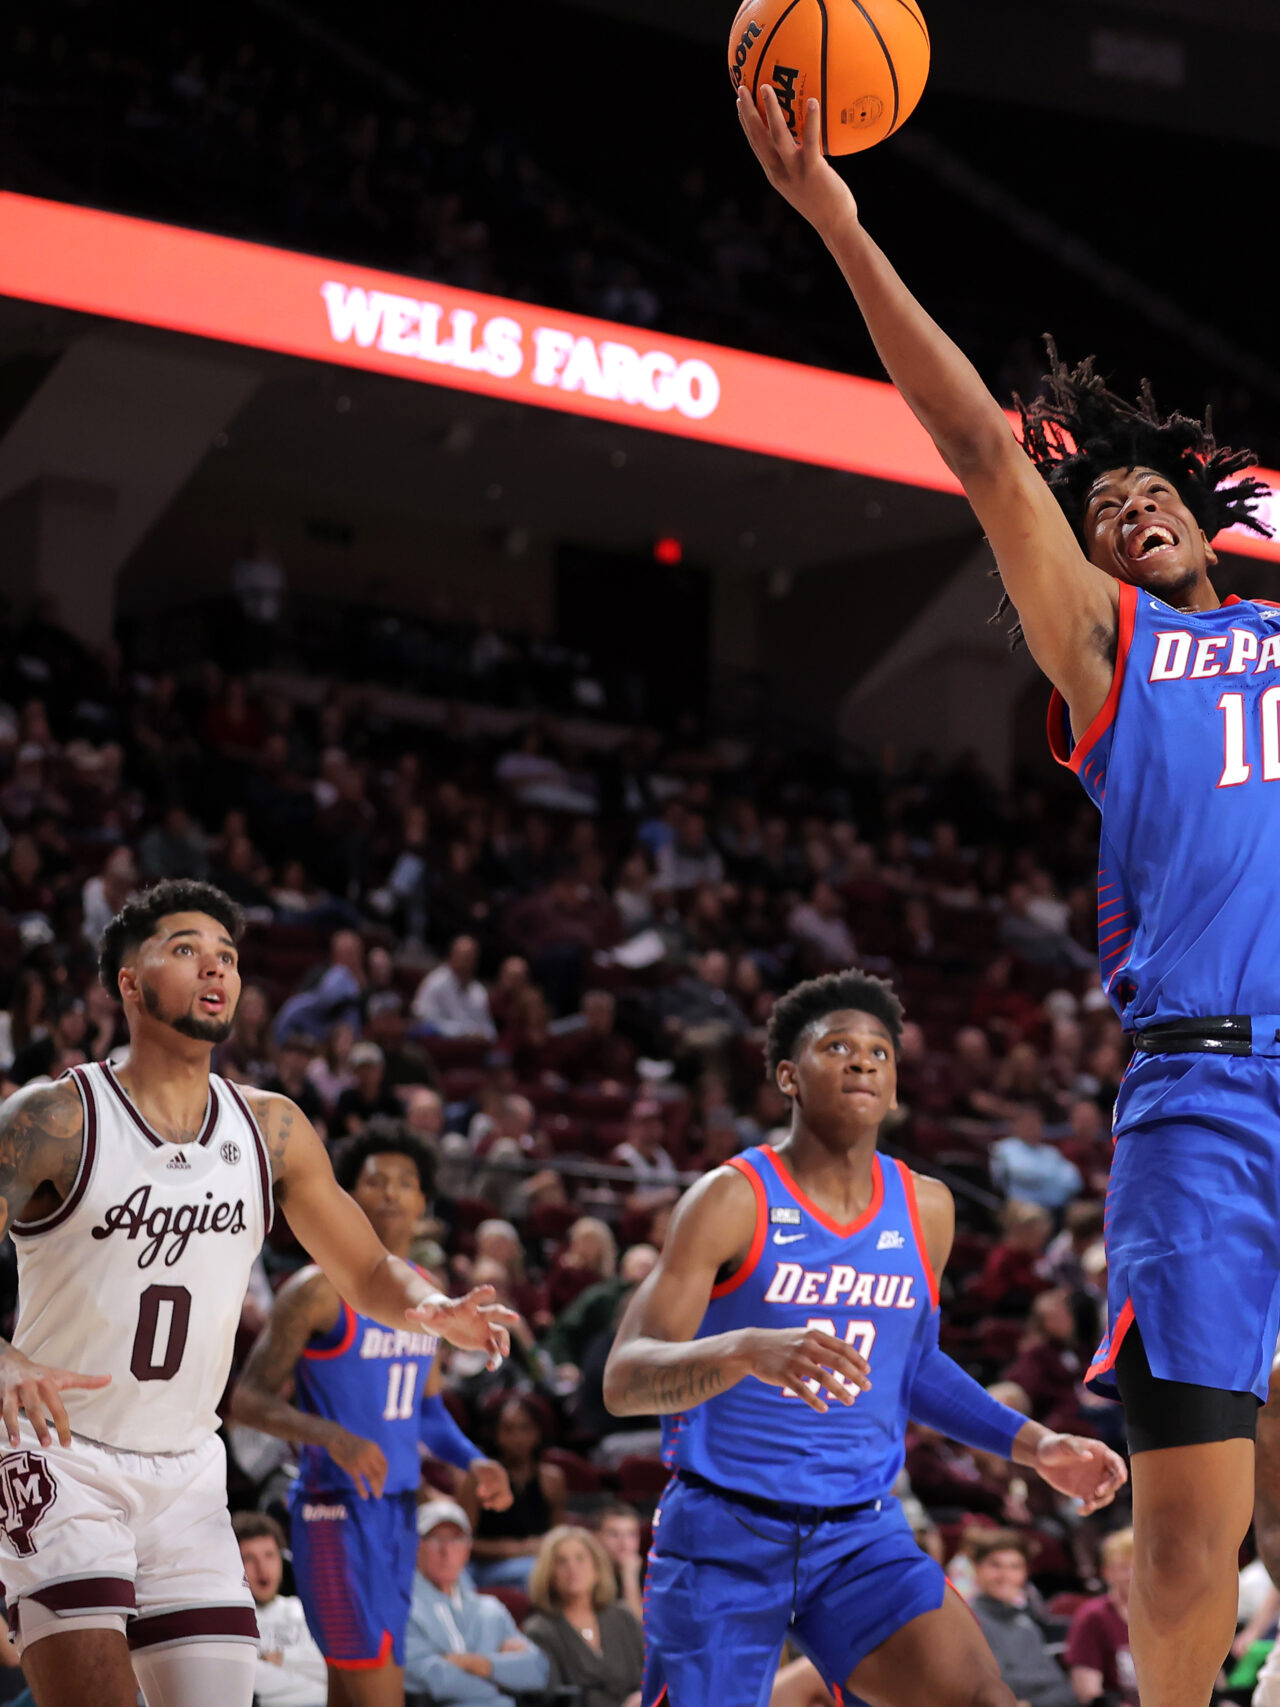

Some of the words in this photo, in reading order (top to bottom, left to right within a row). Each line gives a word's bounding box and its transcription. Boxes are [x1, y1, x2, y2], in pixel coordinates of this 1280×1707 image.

[321, 279, 523, 378] WELLS
[531, 325, 721, 419] FARGO
[91, 1184, 246, 1269] Aggies
[130, 1284, 192, 1381] 0
[383, 1362, 418, 1421] 11
